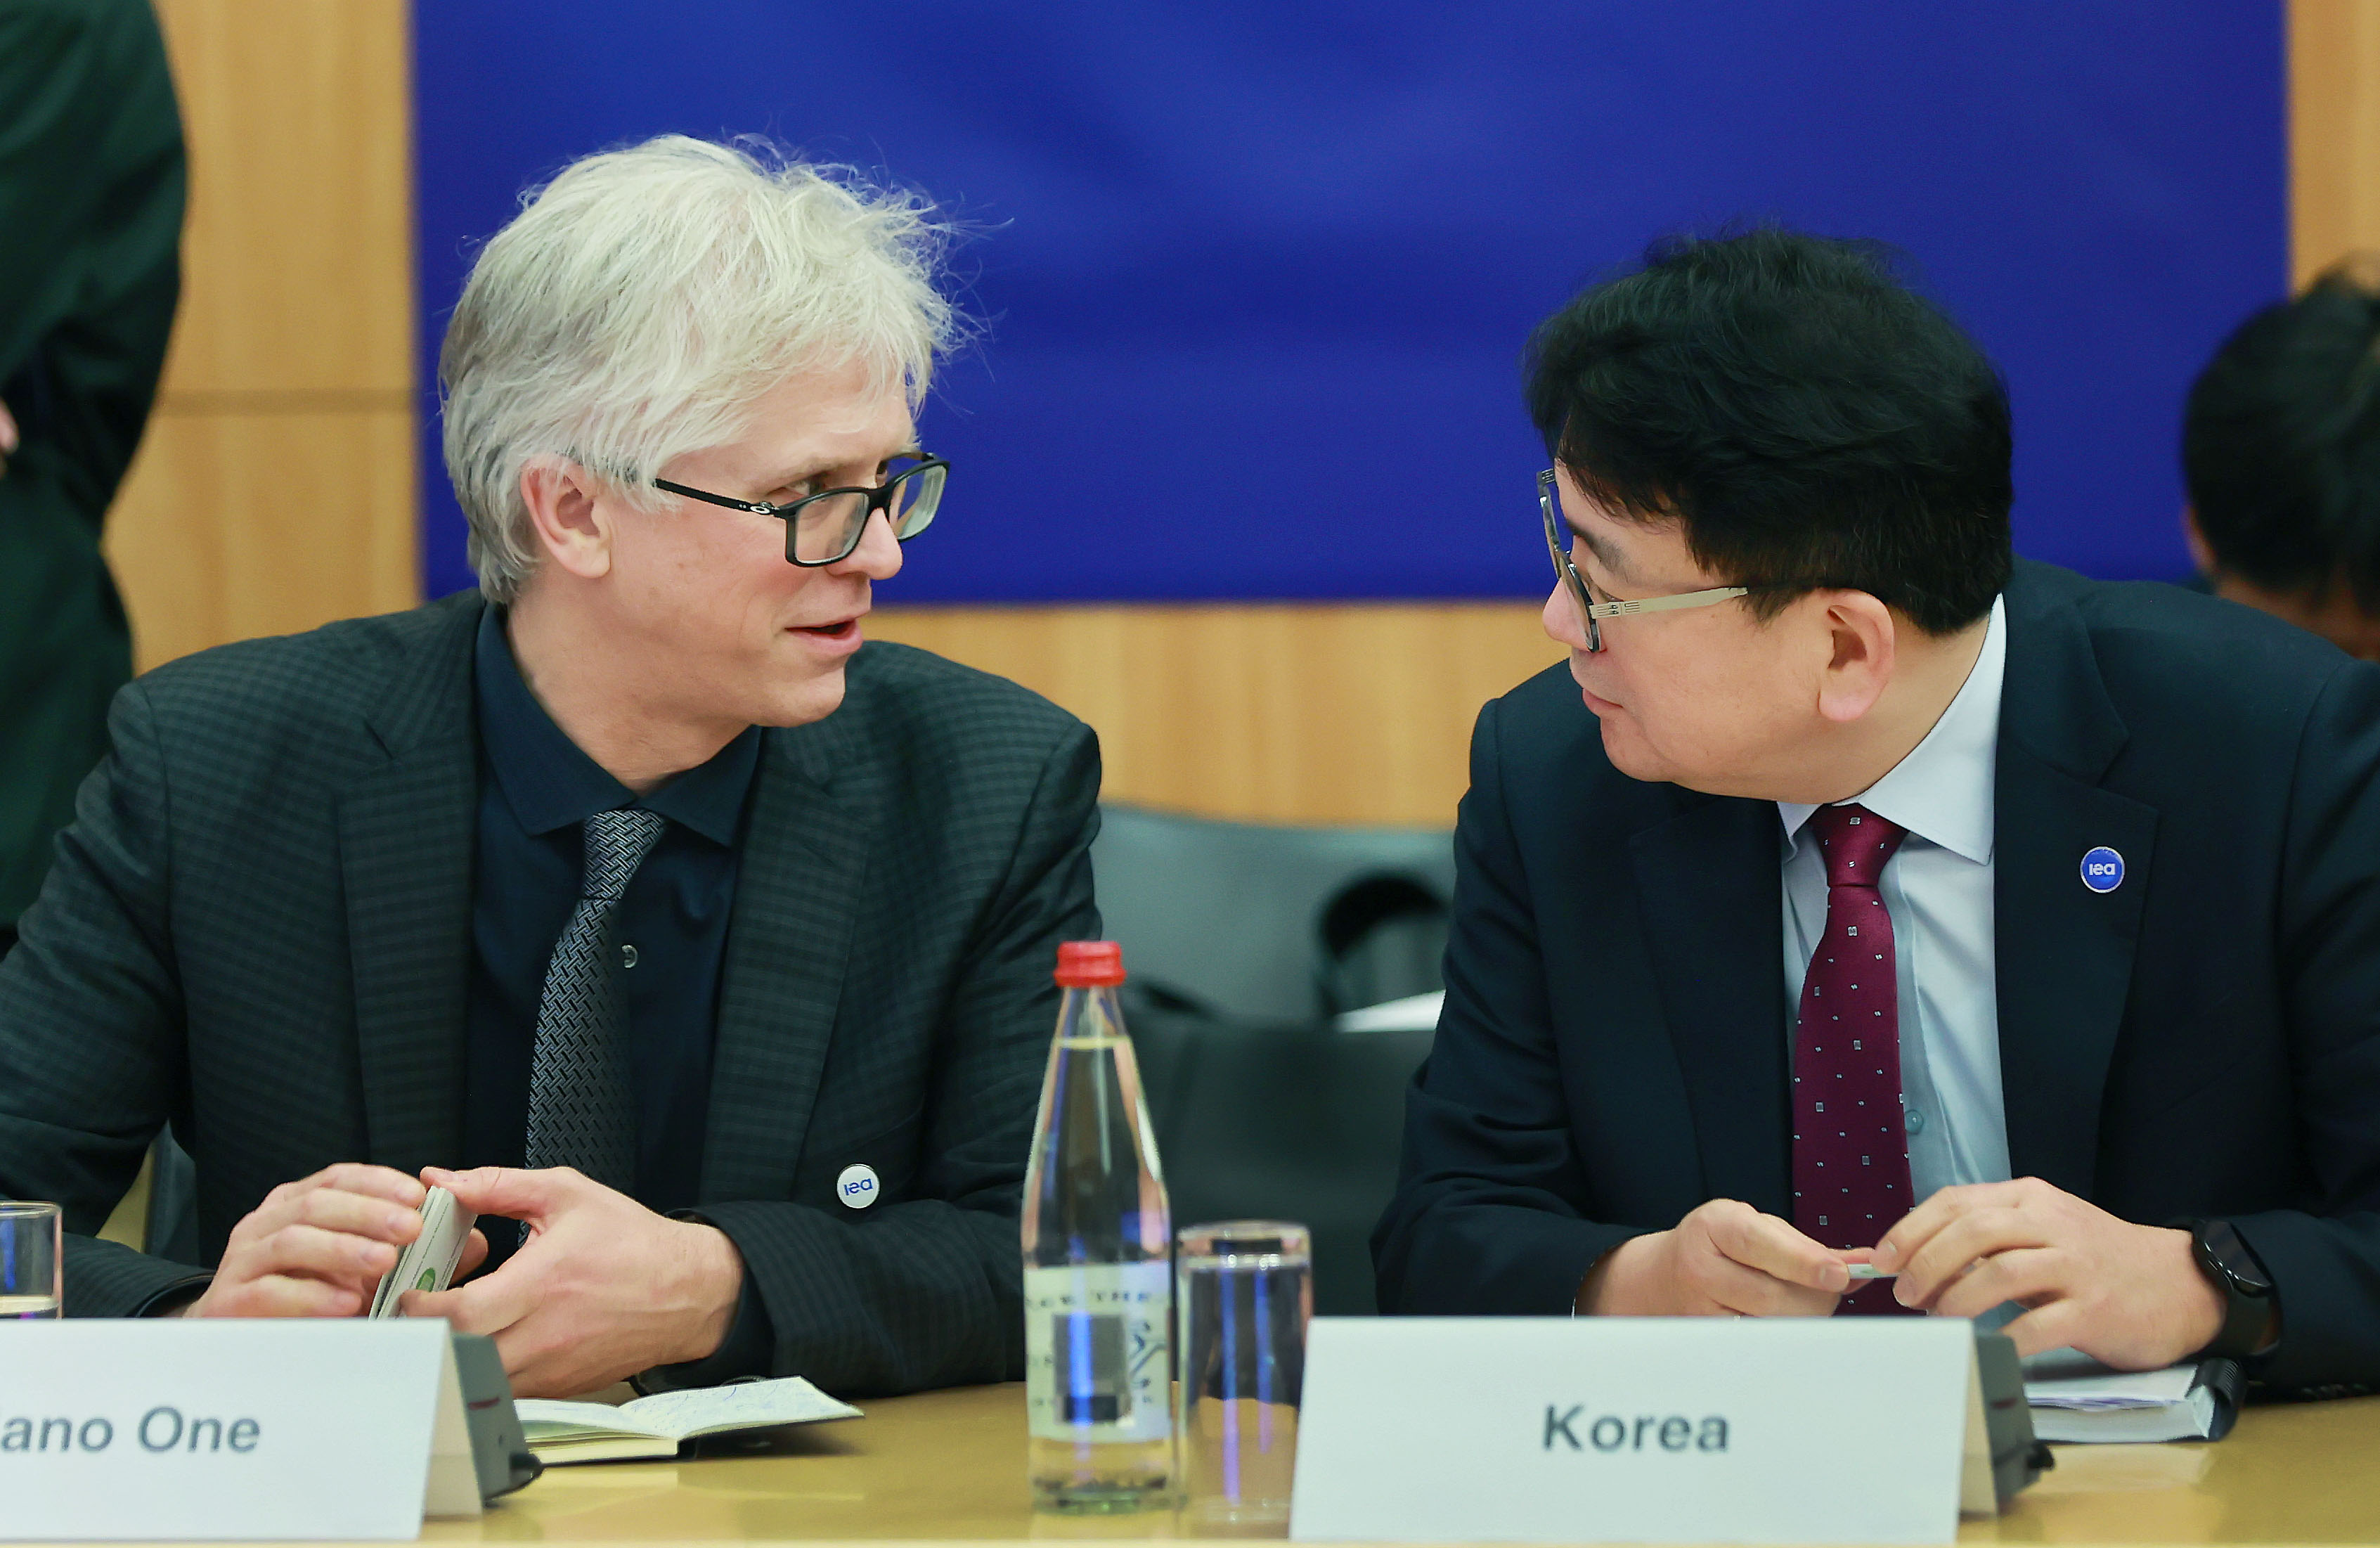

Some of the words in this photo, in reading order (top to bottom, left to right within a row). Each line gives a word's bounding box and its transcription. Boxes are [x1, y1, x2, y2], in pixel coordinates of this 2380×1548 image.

[0, 1417, 112, 1452] ano
[138, 1406, 260, 1452] One
[1543, 1405, 1729, 1452] Korea
